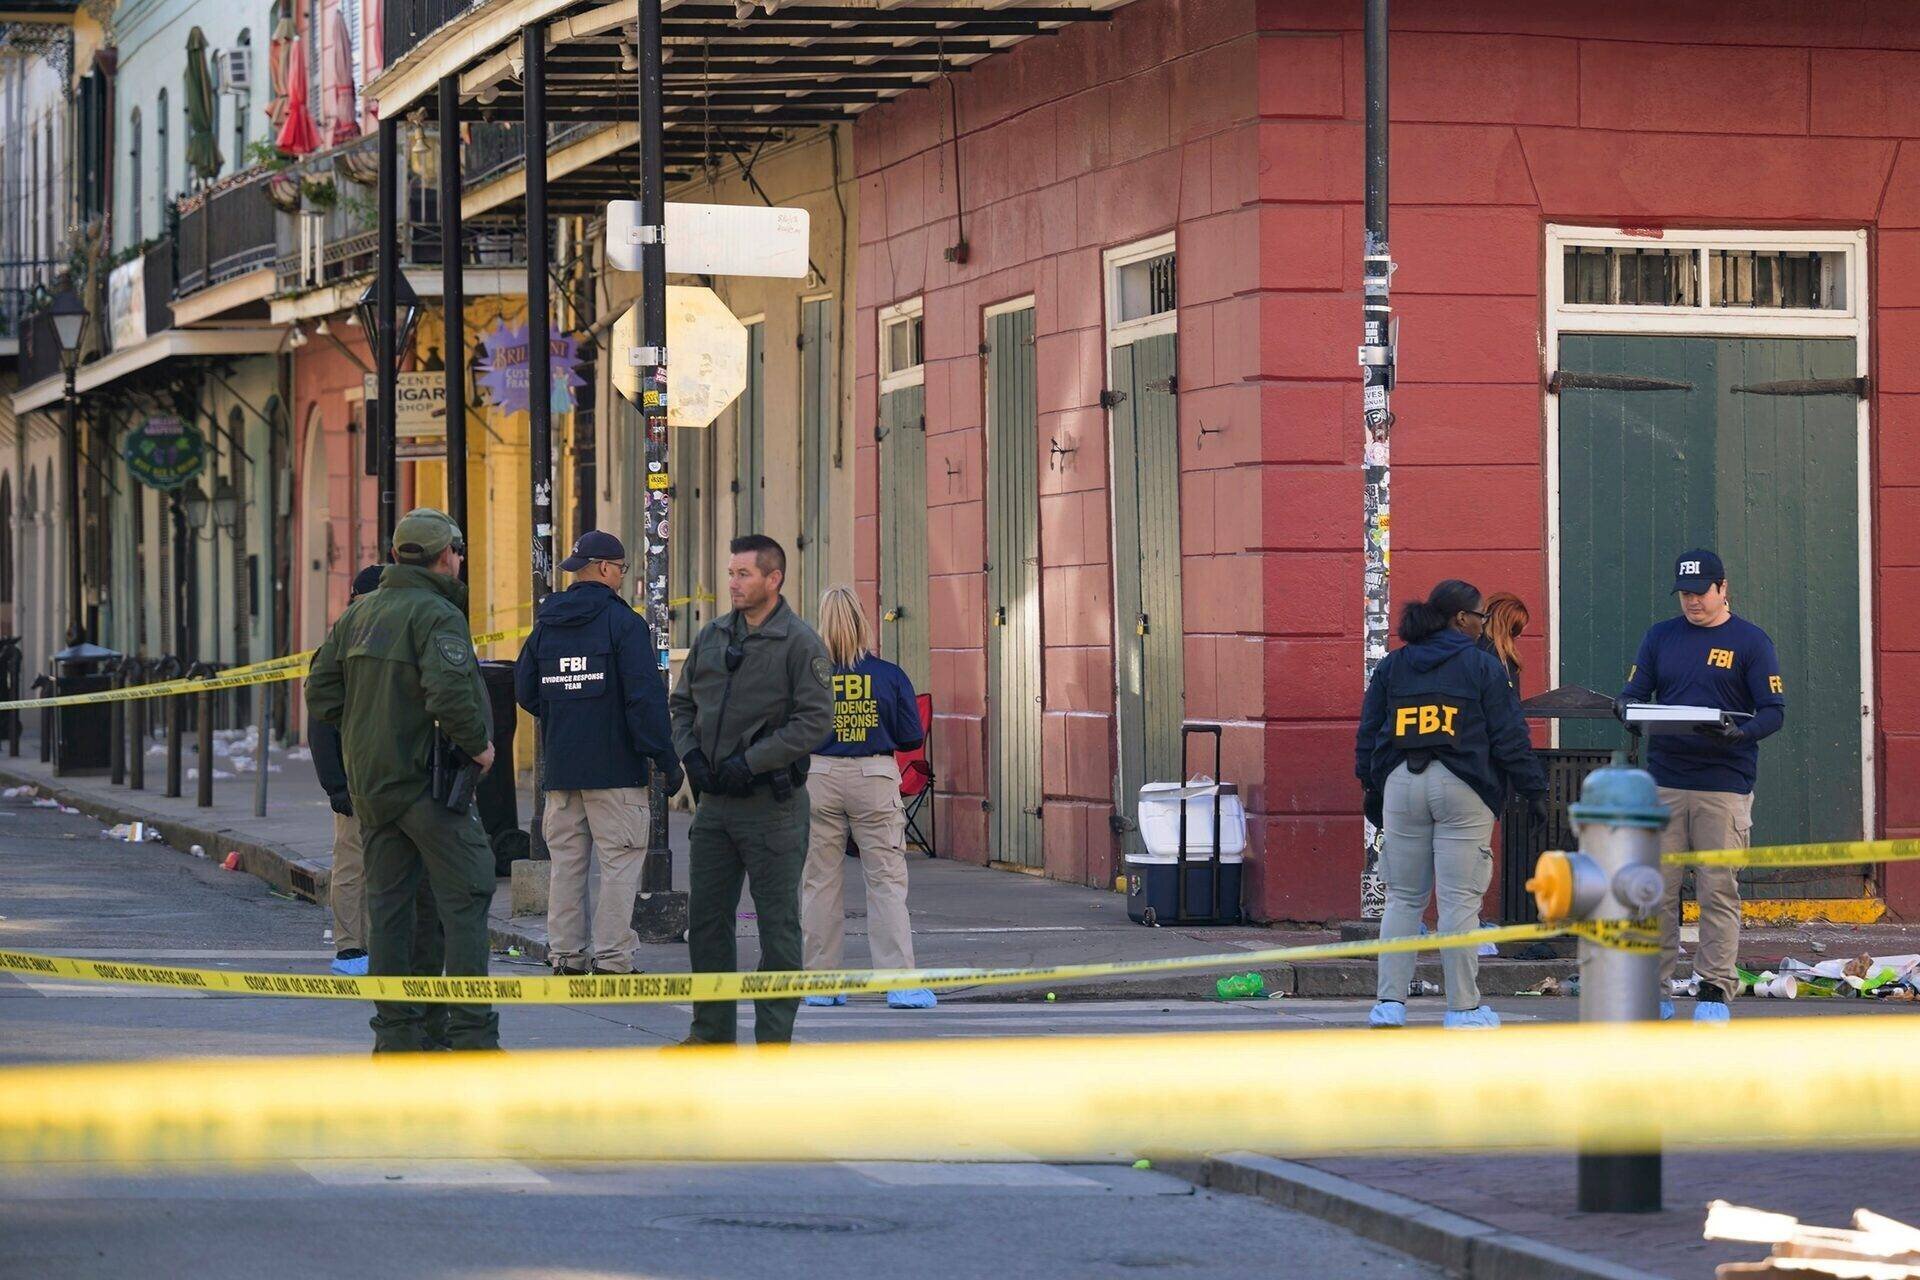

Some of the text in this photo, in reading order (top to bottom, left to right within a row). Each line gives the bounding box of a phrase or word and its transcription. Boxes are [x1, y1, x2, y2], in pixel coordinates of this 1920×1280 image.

[494, 341, 568, 369] BRILNT
[505, 367, 530, 379] CUST
[398, 387, 446, 401] IGAR
[1678, 560, 1701, 576] FBI
[560, 656, 587, 673] FBI
[1706, 648, 1735, 669] FBI
[541, 672, 604, 684] EVIDENCE RESPONSE
[565, 682, 582, 690] TEAM
[832, 674, 872, 701] FBI
[835, 700, 878, 715] IDENCE
[833, 713, 879, 729] ESPONSE
[1395, 704, 1459, 737] FBI
[836, 728, 867, 742] TEAM
[244, 975, 361, 995] CRIME SCENE DO NOT CROSS
[402, 980, 522, 998] CRIME SCENE DO NOT CROSS
[568, 977, 692, 998] CRIME SCENE DO NOT CROSS
